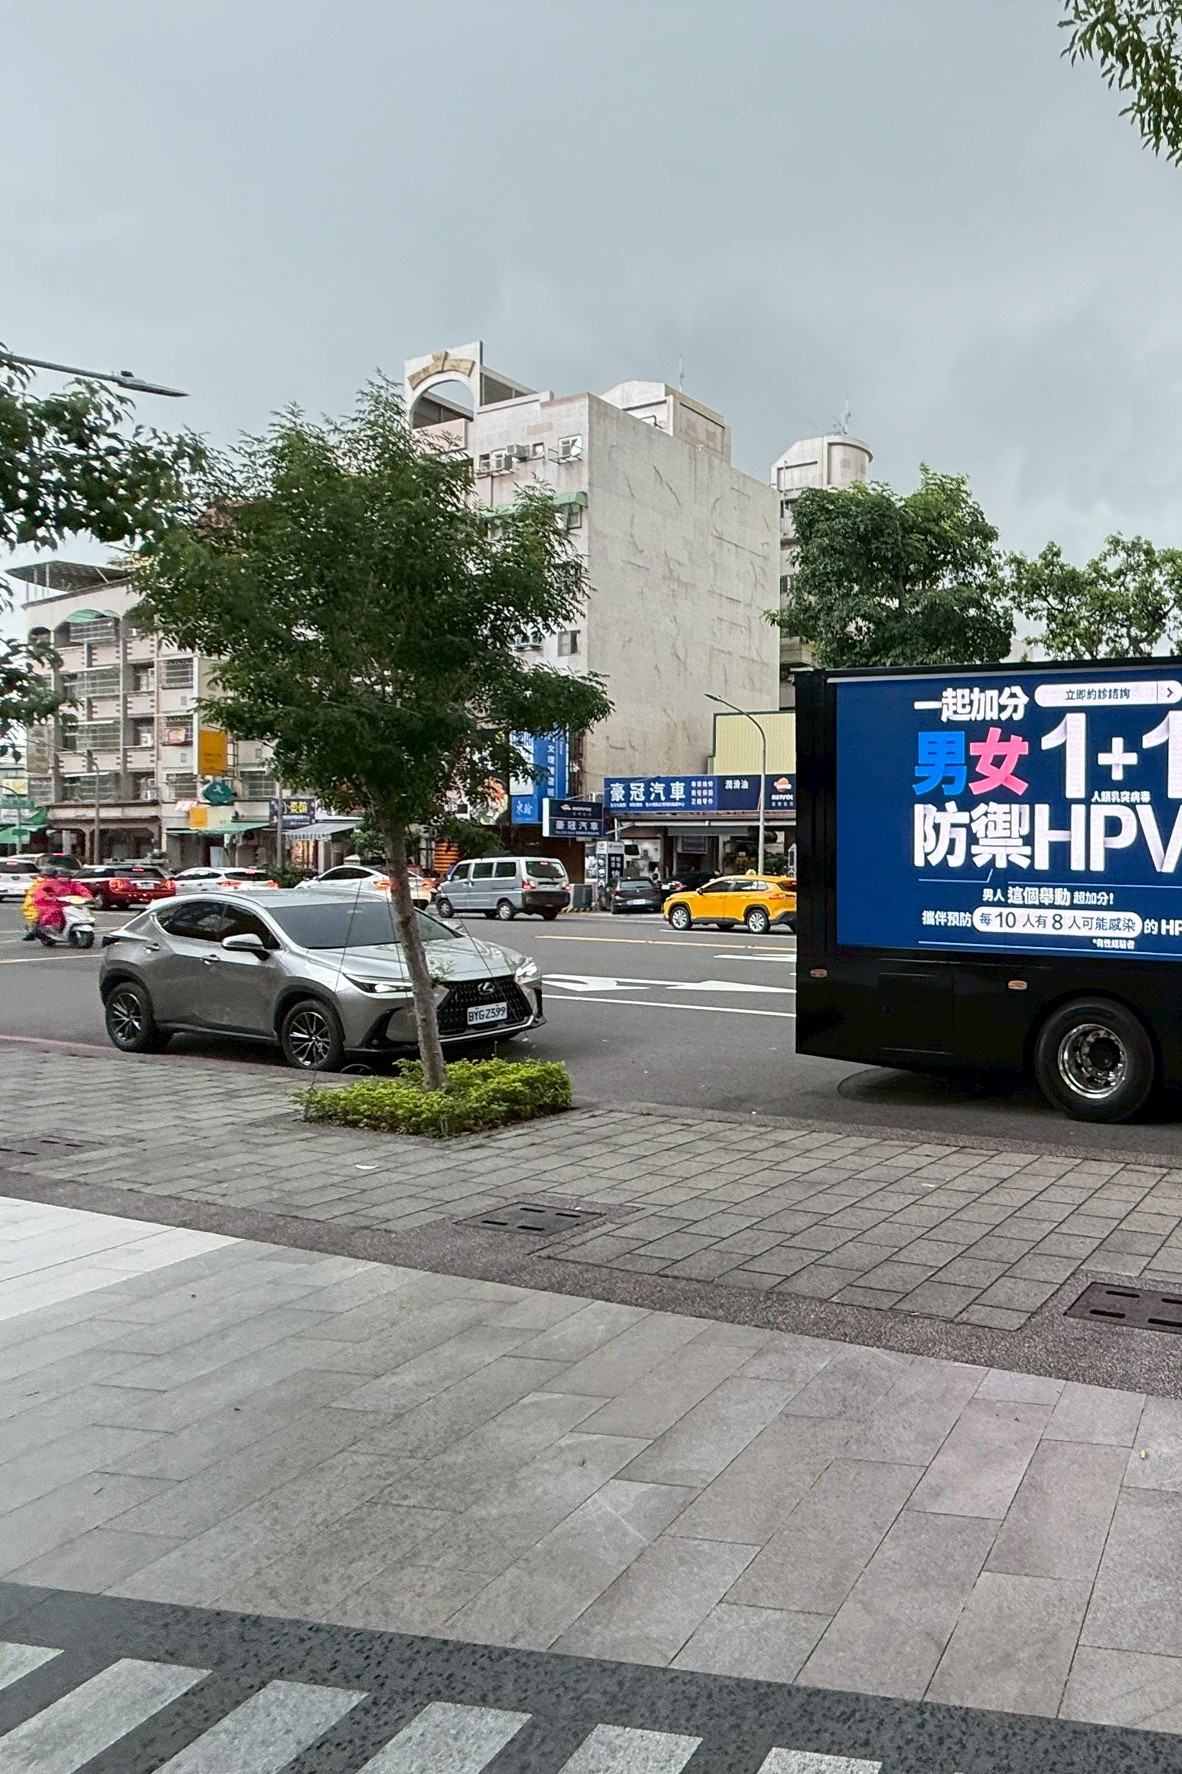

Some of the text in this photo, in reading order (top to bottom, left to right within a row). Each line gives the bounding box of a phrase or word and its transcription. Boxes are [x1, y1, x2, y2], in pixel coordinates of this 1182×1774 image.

[914, 685, 1030, 722] 一起加分
[912, 727, 1029, 795] 男女
[610, 781, 686, 802] 豪冠汽車
[1091, 791, 1151, 803] 人類乳突病毒
[982, 886, 1114, 906] 男人 這個舉動 超加分!
[922, 910, 972, 927] 攜伴預防
[995, 911, 1017, 928] 10
[1051, 913, 1063, 931] 8
[1068, 915, 1136, 932] 人可能感染
[1143, 918, 1159, 935] 的
